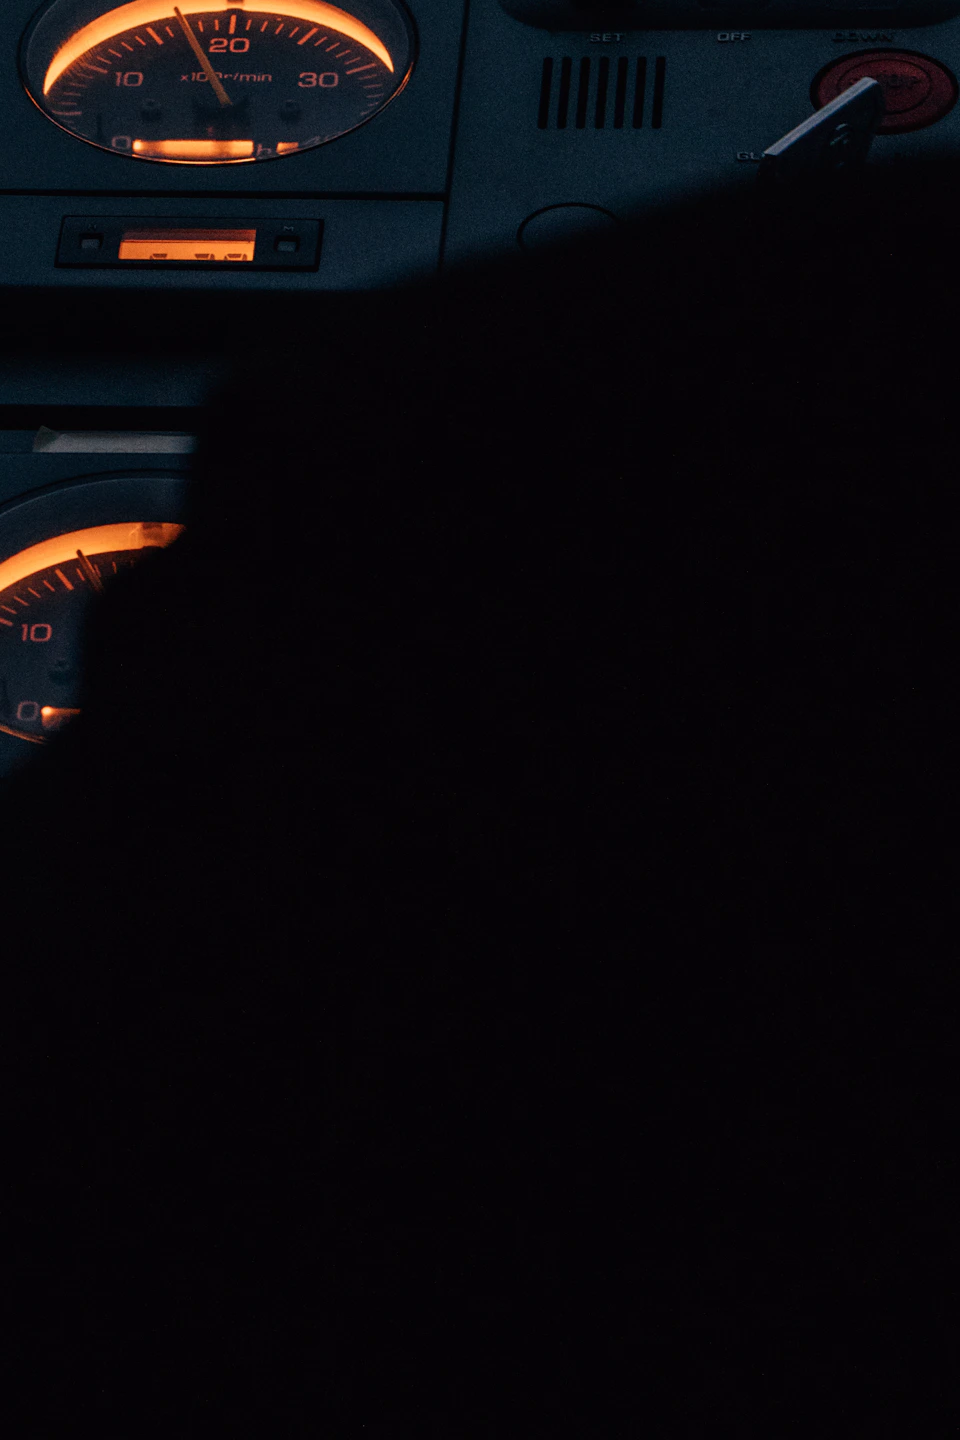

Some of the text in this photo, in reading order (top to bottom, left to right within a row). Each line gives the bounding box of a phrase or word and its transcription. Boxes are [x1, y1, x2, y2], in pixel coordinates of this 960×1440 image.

[209, 37, 249, 53] 20
[590, 32, 624, 43] SET
[717, 32, 751, 43] OFF
[115, 72, 144, 87] 10
[297, 72, 339, 88] 30
[20, 623, 53, 643] 10
[16, 701, 40, 722] 0
